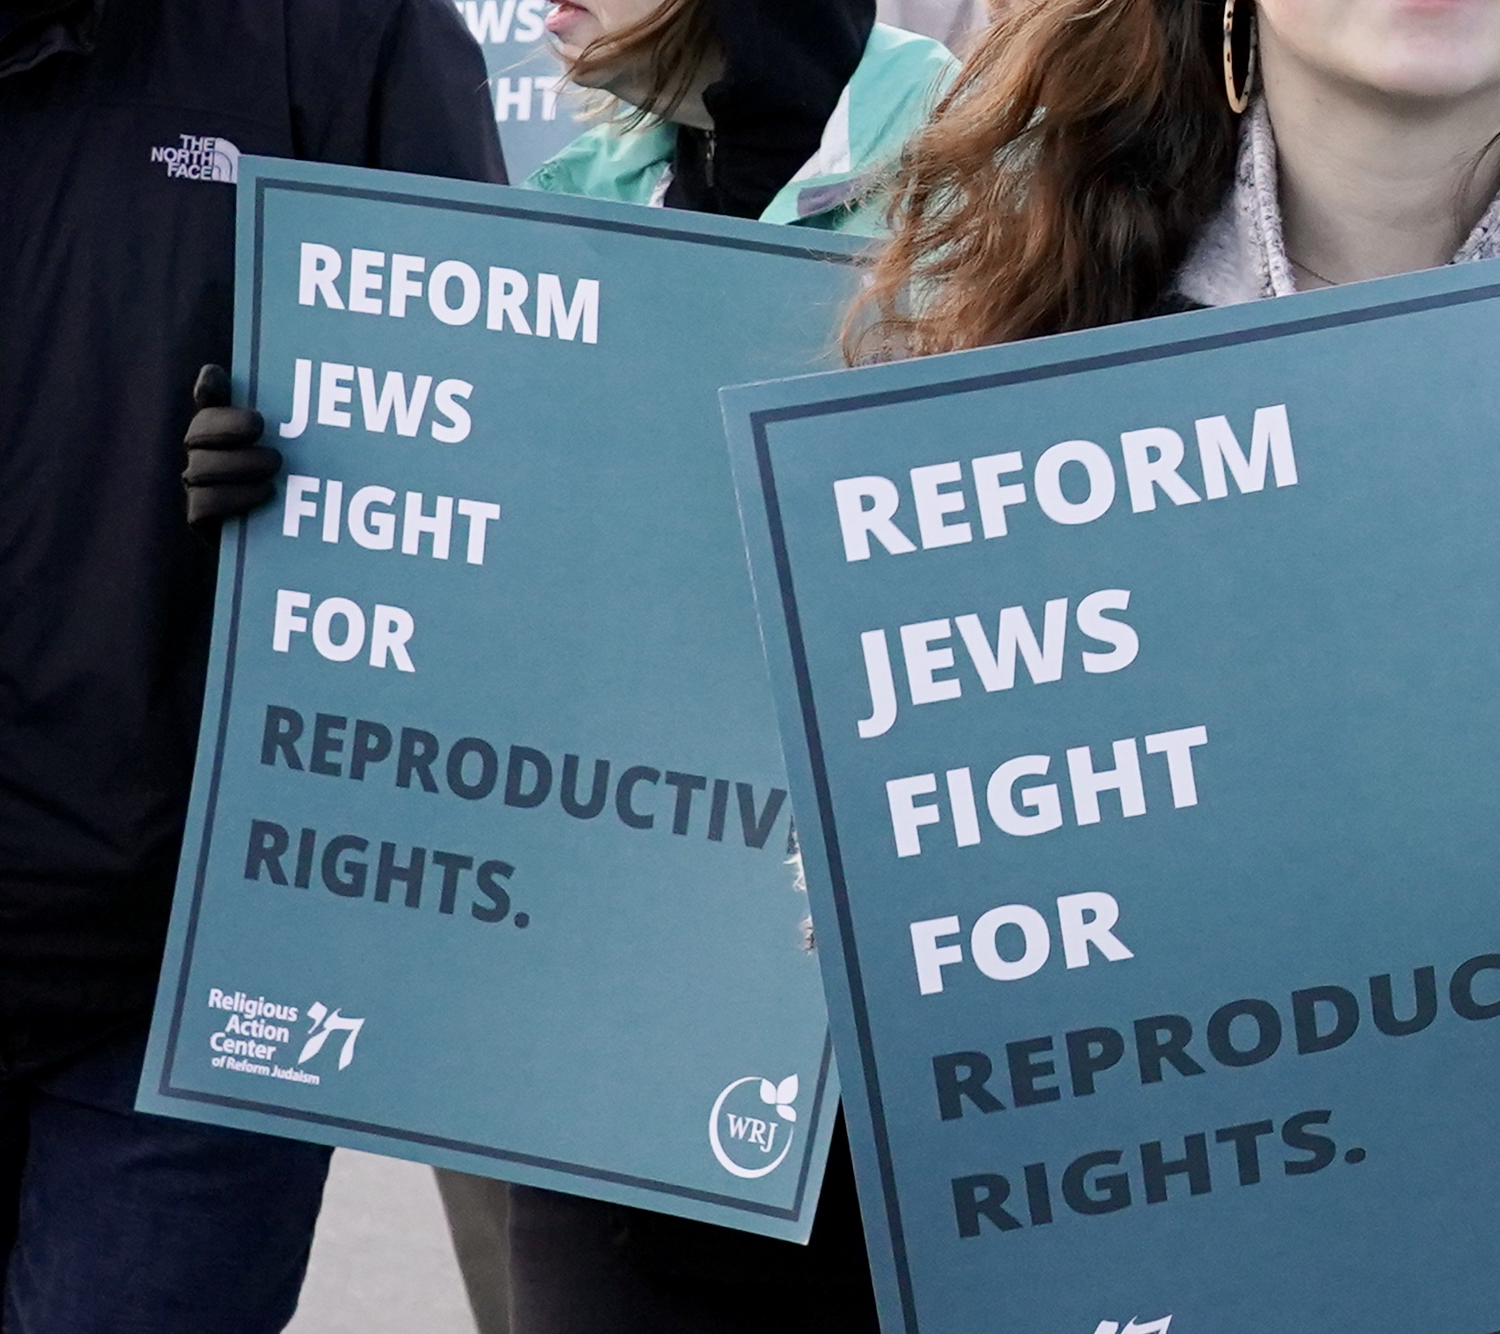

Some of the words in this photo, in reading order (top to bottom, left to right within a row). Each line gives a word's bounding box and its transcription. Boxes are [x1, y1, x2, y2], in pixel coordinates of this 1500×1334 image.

[151, 147, 213, 166] NORTH
[167, 162, 212, 180] FACE
[180, 133, 215, 151] THE
[298, 242, 600, 344] REFORM
[280, 358, 474, 443] JEWS
[283, 475, 501, 565] FIGHT
[833, 404, 1298, 562] REFORM
[272, 589, 416, 673] FOR
[857, 588, 1141, 739] JEWS
[260, 704, 797, 854] REPRODUCTIV
[885, 725, 1208, 858] FIGHT
[243, 818, 530, 929] RIGHTS.
[910, 891, 1134, 995] FOR
[208, 988, 298, 1021] Religious
[210, 1032, 276, 1060] Center
[225, 1014, 289, 1043] Action
[212, 1055, 226, 1068] of
[226, 1057, 271, 1076] Reform
[271, 1065, 320, 1085] Judaism
[727, 1113, 779, 1153] WRJ
[950, 1108, 1368, 1240] RIGHTS.
